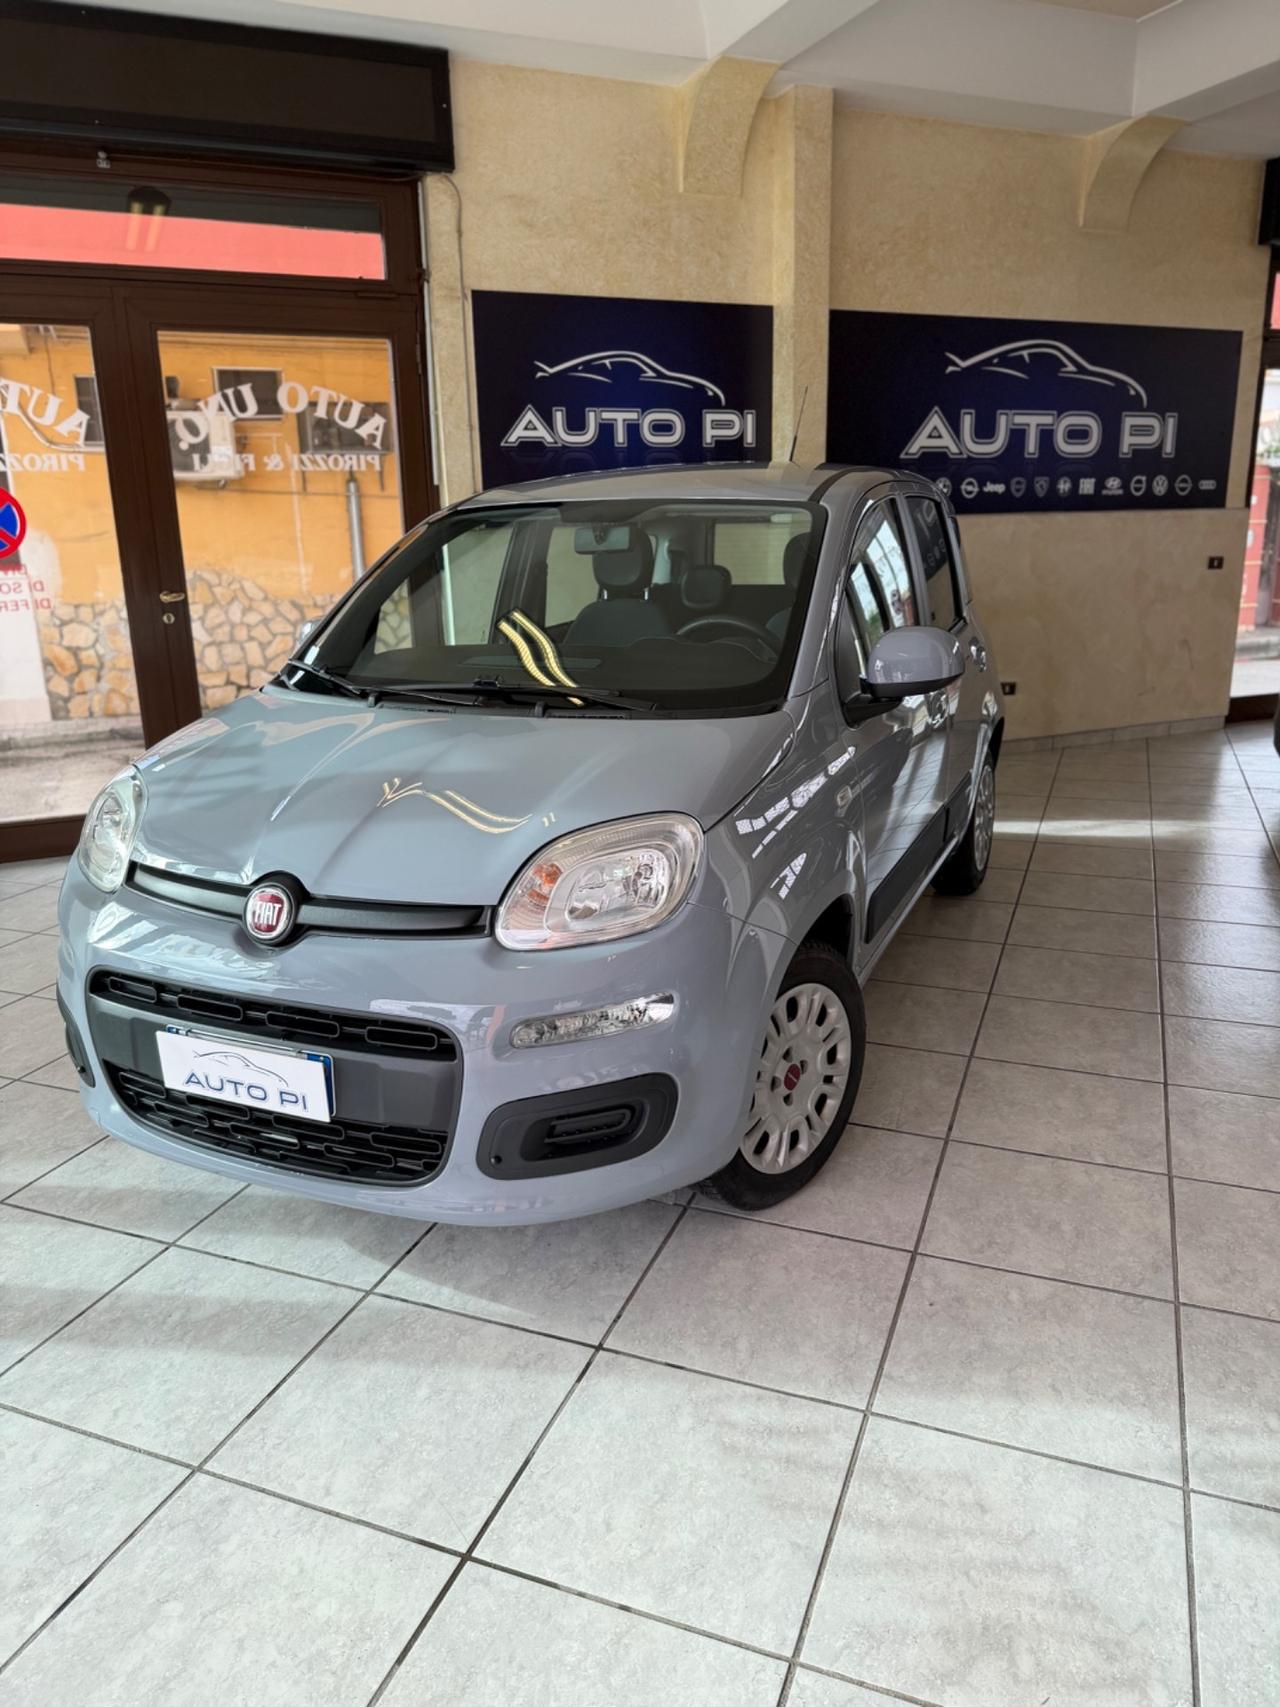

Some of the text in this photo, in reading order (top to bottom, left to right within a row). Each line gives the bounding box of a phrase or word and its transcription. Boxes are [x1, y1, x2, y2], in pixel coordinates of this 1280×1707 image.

[500, 404, 756, 448] AUTO PI
[899, 406, 1179, 459] AUTO PI
[254, 900, 282, 926] FIAT
[184, 1071, 309, 1112] AUTO PI
